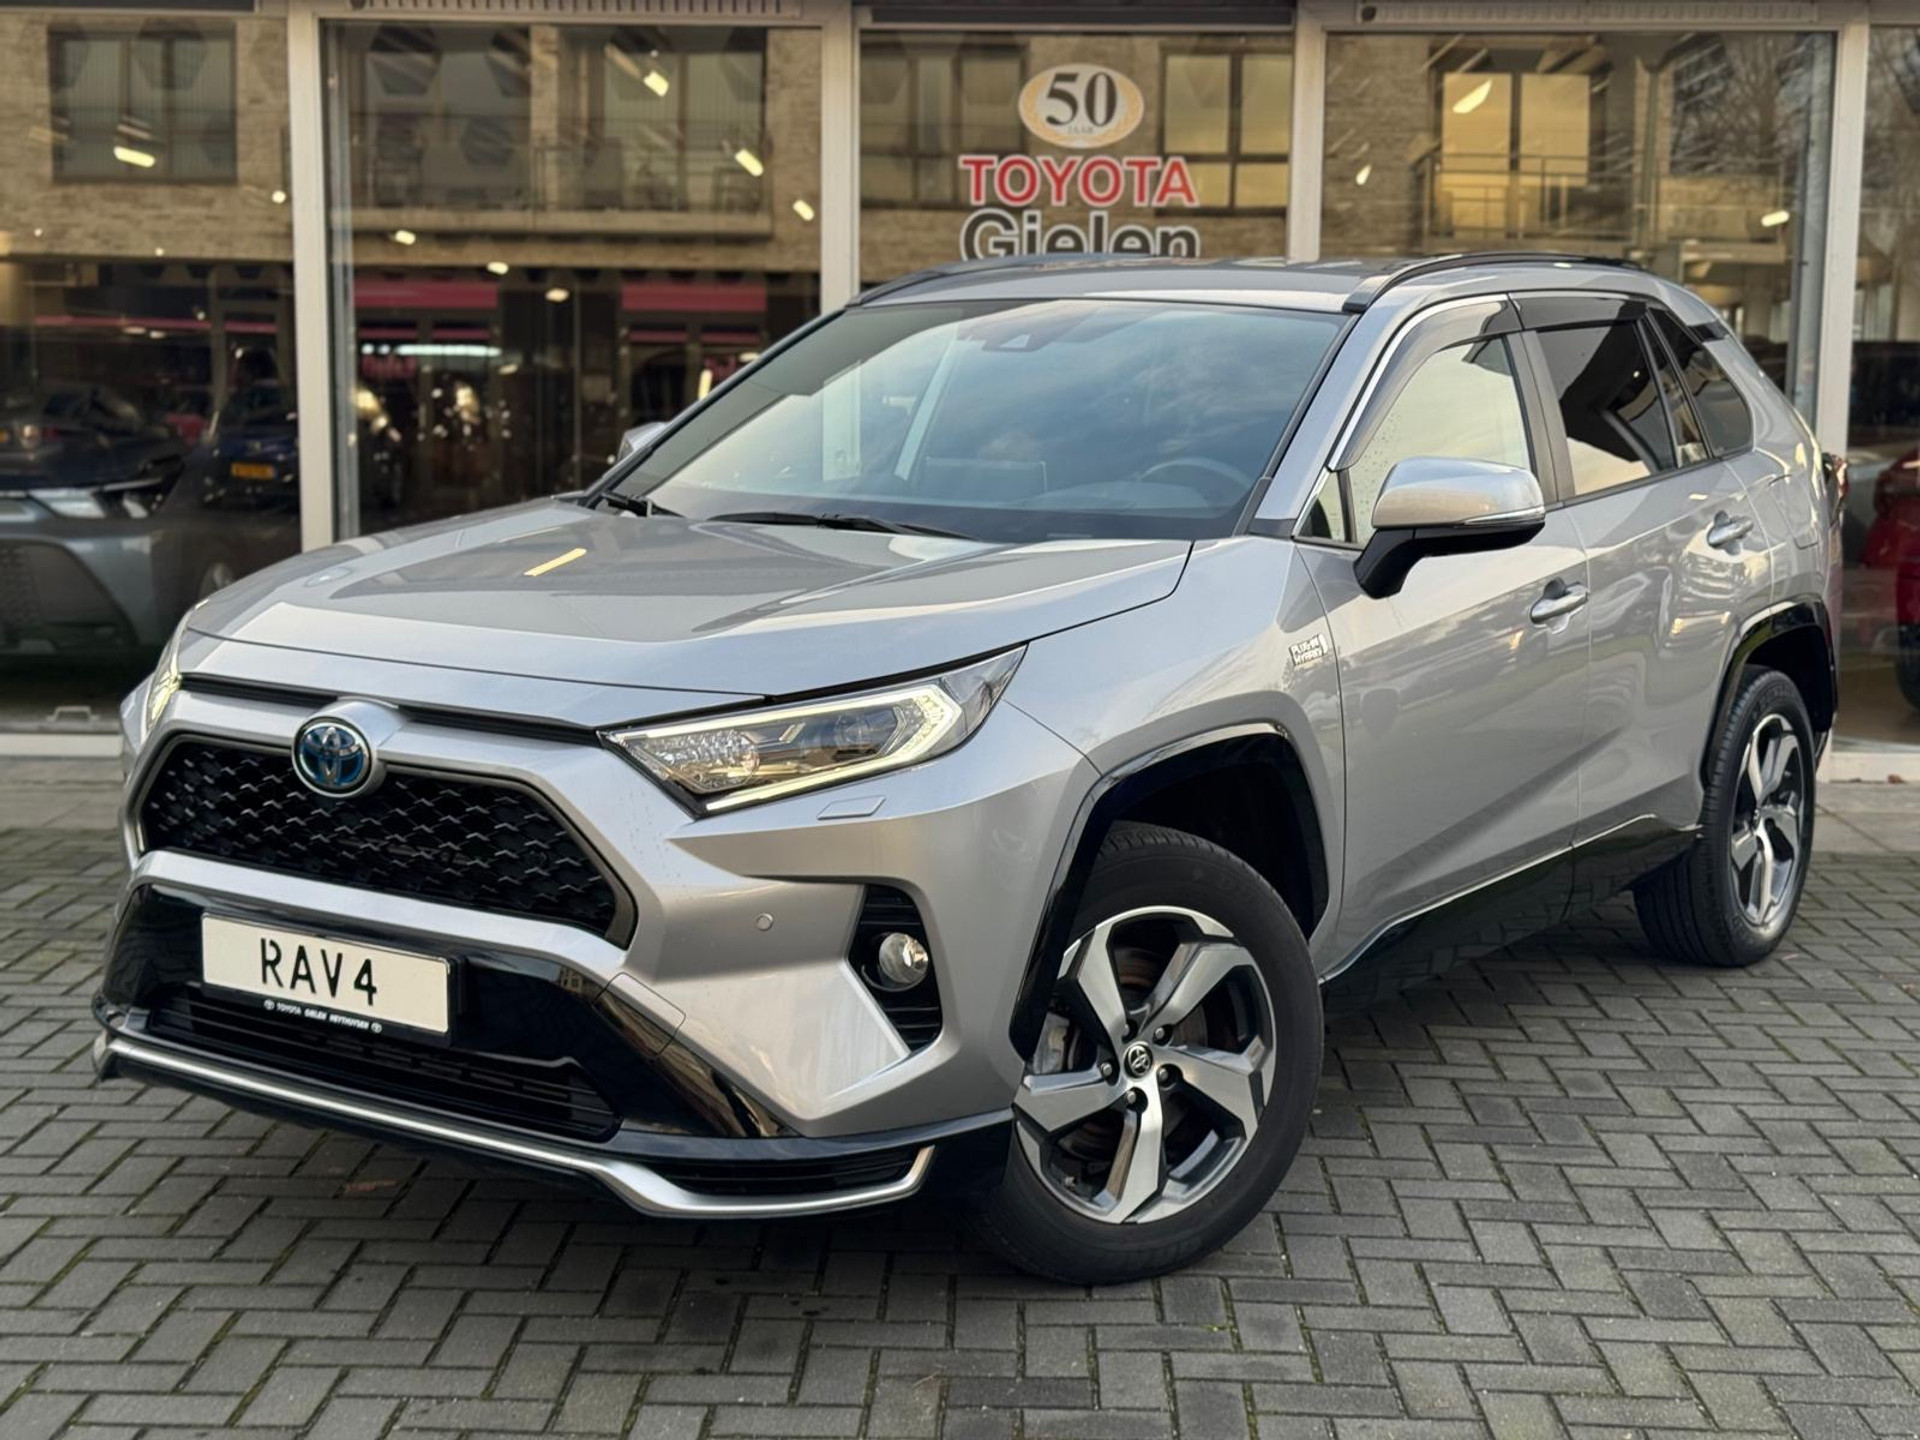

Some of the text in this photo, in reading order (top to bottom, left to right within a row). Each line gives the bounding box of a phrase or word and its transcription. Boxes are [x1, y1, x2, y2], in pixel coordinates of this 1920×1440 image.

[1045, 72, 1117, 127] 50
[959, 155, 1199, 206] TOYOTA
[960, 208, 1200, 261] Gielen
[276, 1002, 302, 1016] TOYOTA
